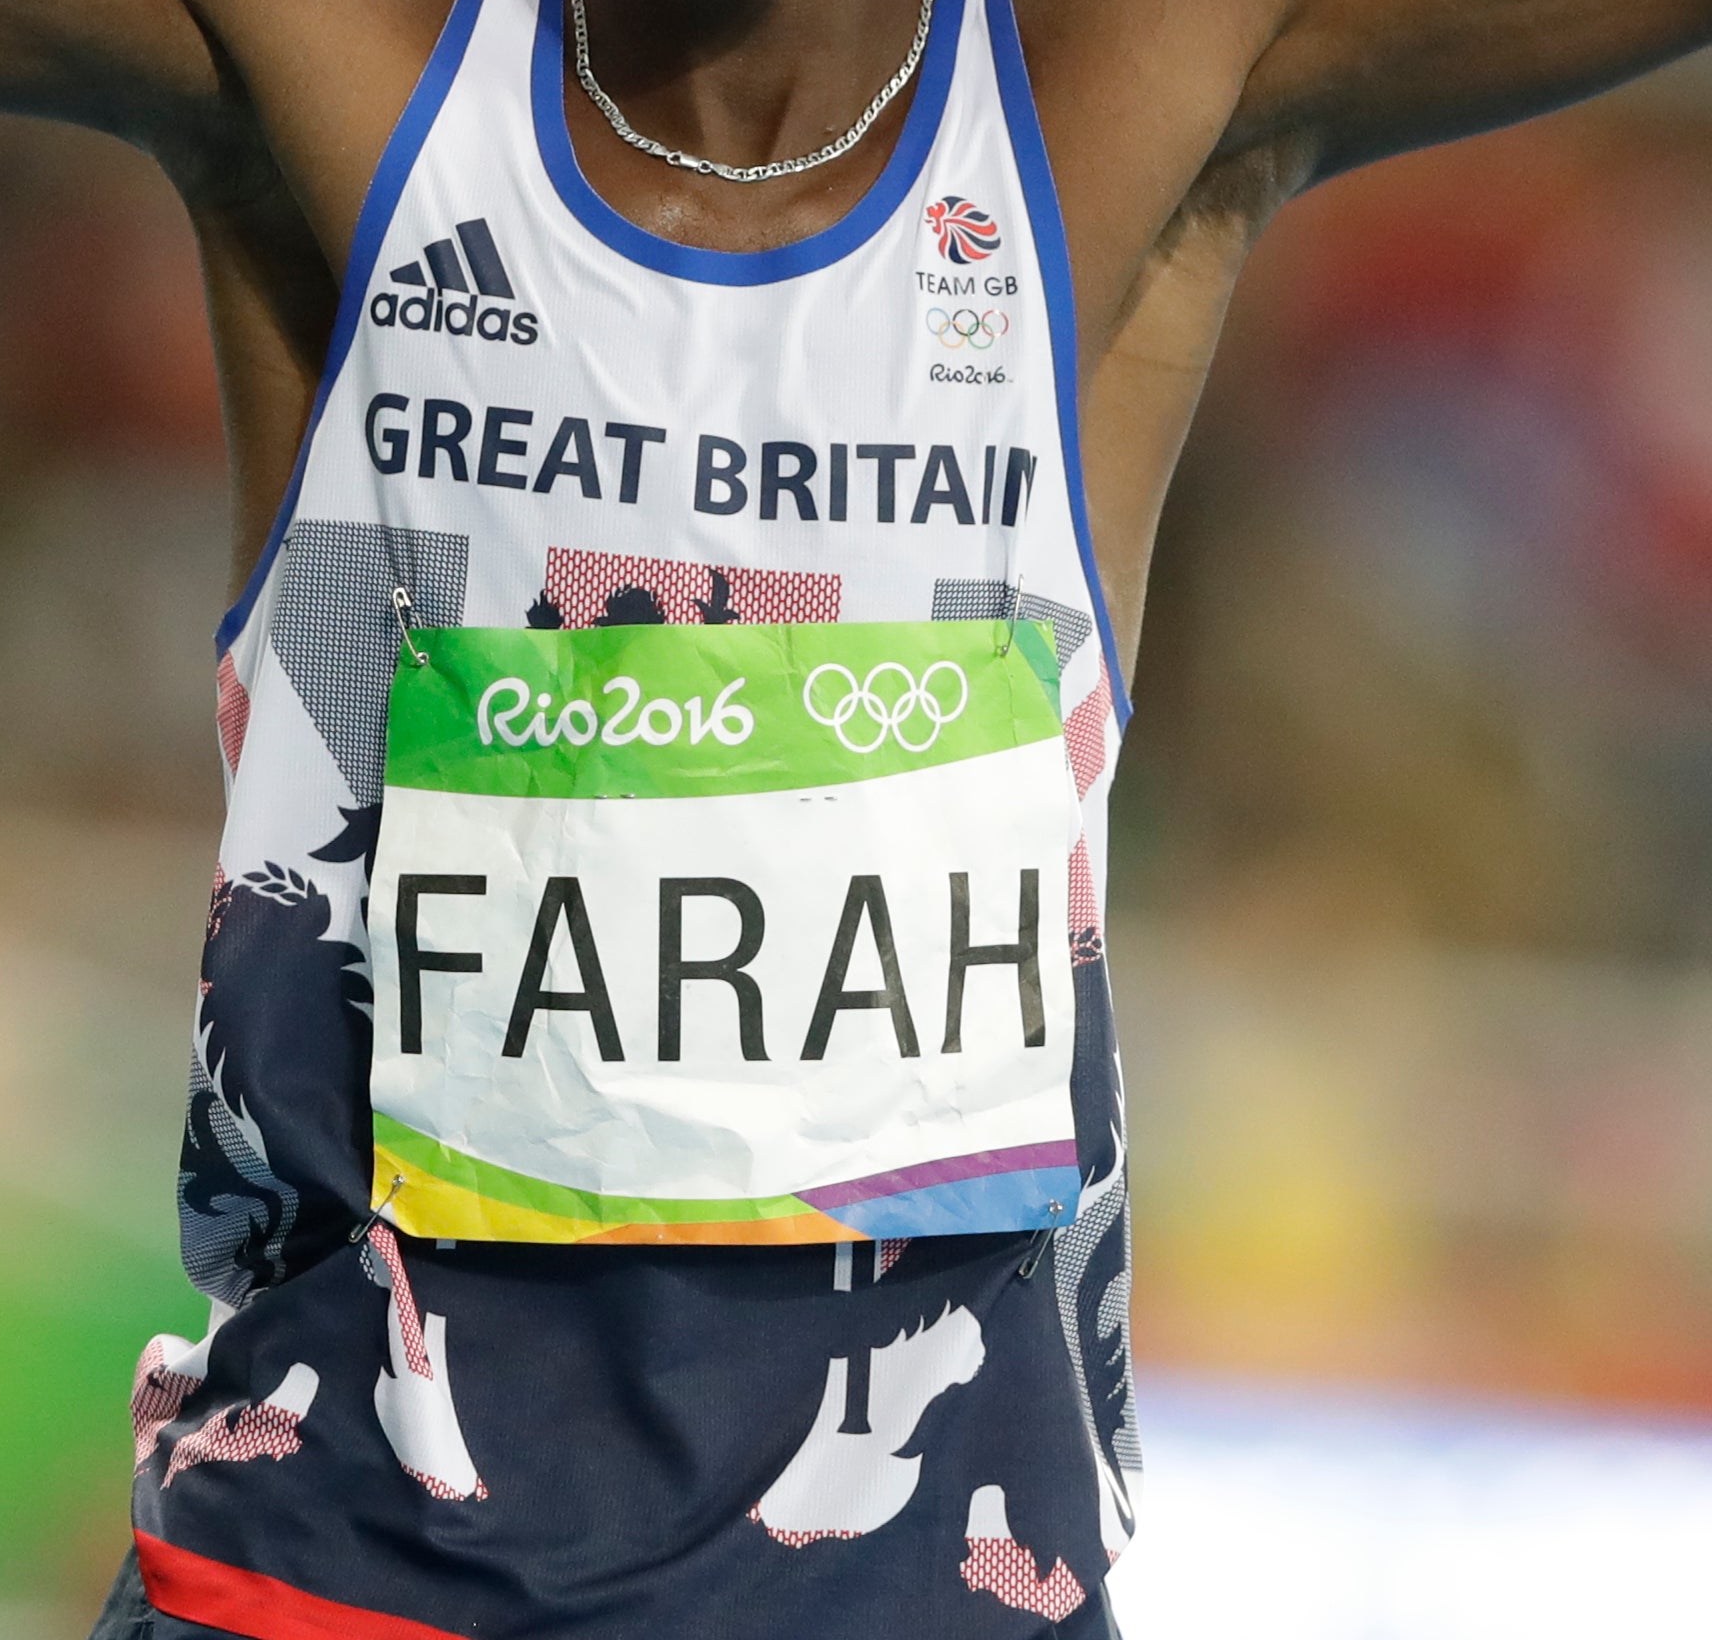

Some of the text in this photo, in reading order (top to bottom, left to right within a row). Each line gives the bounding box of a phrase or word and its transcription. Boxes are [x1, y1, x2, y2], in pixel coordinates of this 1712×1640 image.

[370, 287, 539, 346] adidas
[915, 271, 1018, 297] TEAM GB
[363, 392, 1038, 528] GREAT BRITAIN
[477, 675, 755, 747] Rio2016
[395, 868, 1047, 1062] FARAH
